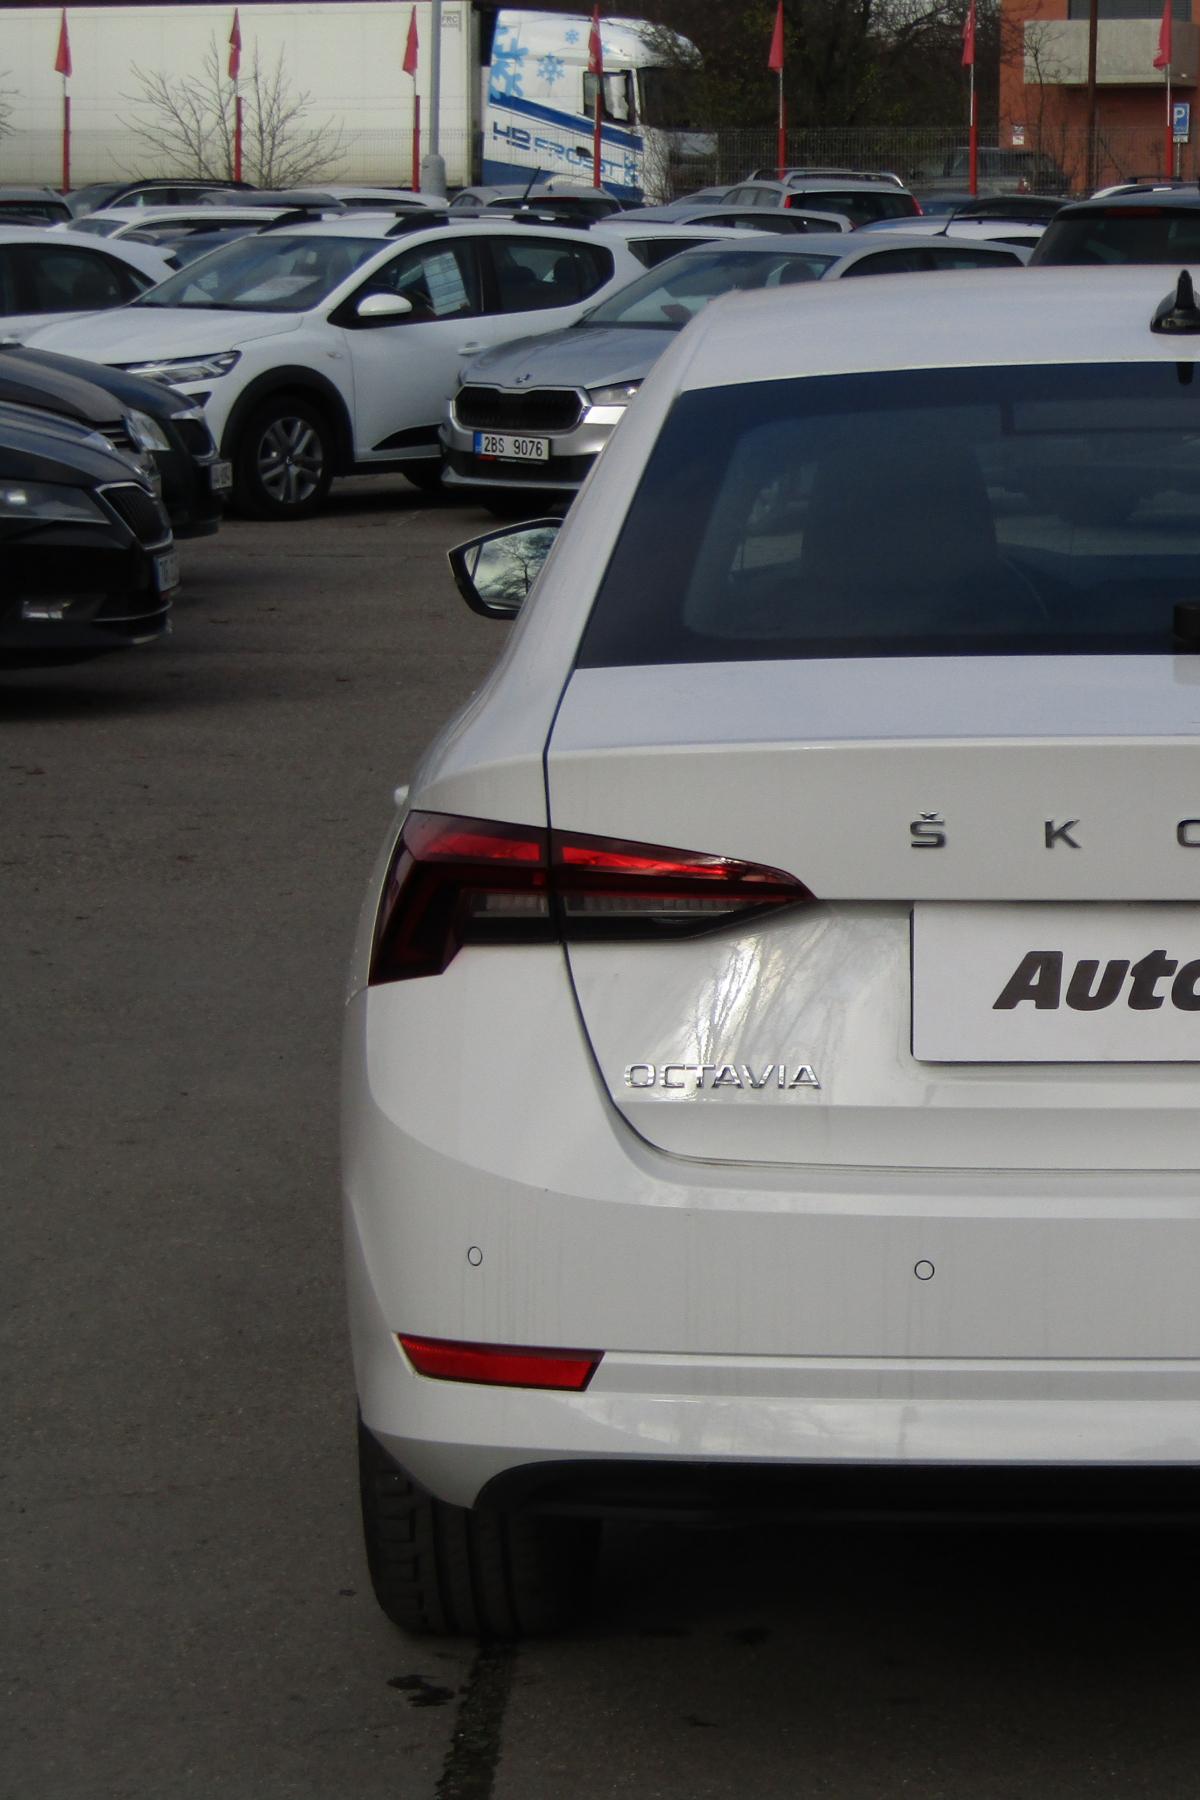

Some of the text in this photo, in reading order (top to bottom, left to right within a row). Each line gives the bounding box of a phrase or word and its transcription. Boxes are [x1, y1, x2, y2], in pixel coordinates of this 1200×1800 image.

[1174, 107, 1185, 125] P
[493, 121, 624, 176] HB FROST
[484, 436, 543, 457] 2BS 9076
[624, 1063, 821, 1089] OCTAVIA
